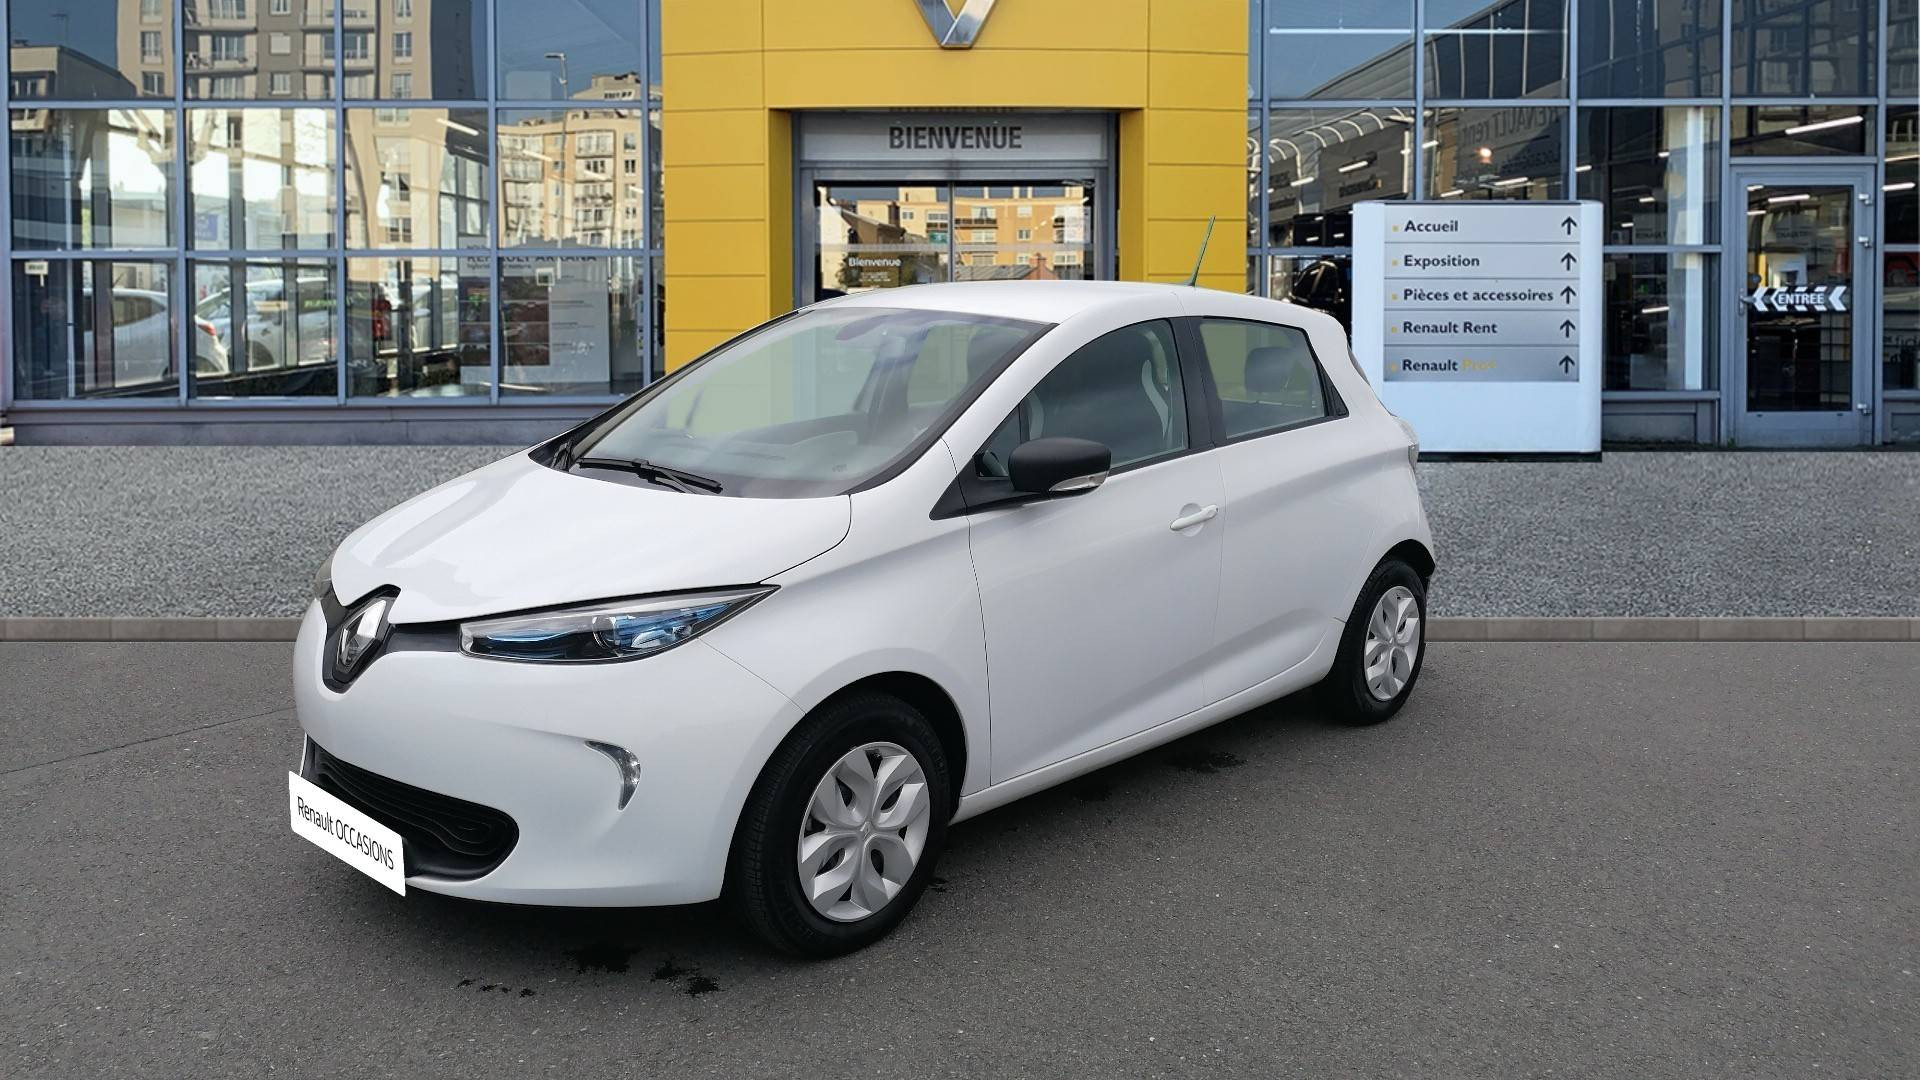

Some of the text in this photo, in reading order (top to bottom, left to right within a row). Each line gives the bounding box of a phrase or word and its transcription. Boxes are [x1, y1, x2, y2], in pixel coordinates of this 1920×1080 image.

[889, 126, 1022, 149] BIENVENUE
[1404, 219, 1459, 233] Accueil
[848, 257, 902, 267] Bienvenue
[1403, 254, 1480, 270] Exposition
[1403, 287, 1554, 301] Pièces et accessoires
[1403, 321, 1498, 334] Renault Rent
[1402, 358, 1458, 372] Renault
[297, 795, 394, 870] Renault OCCASIONS
